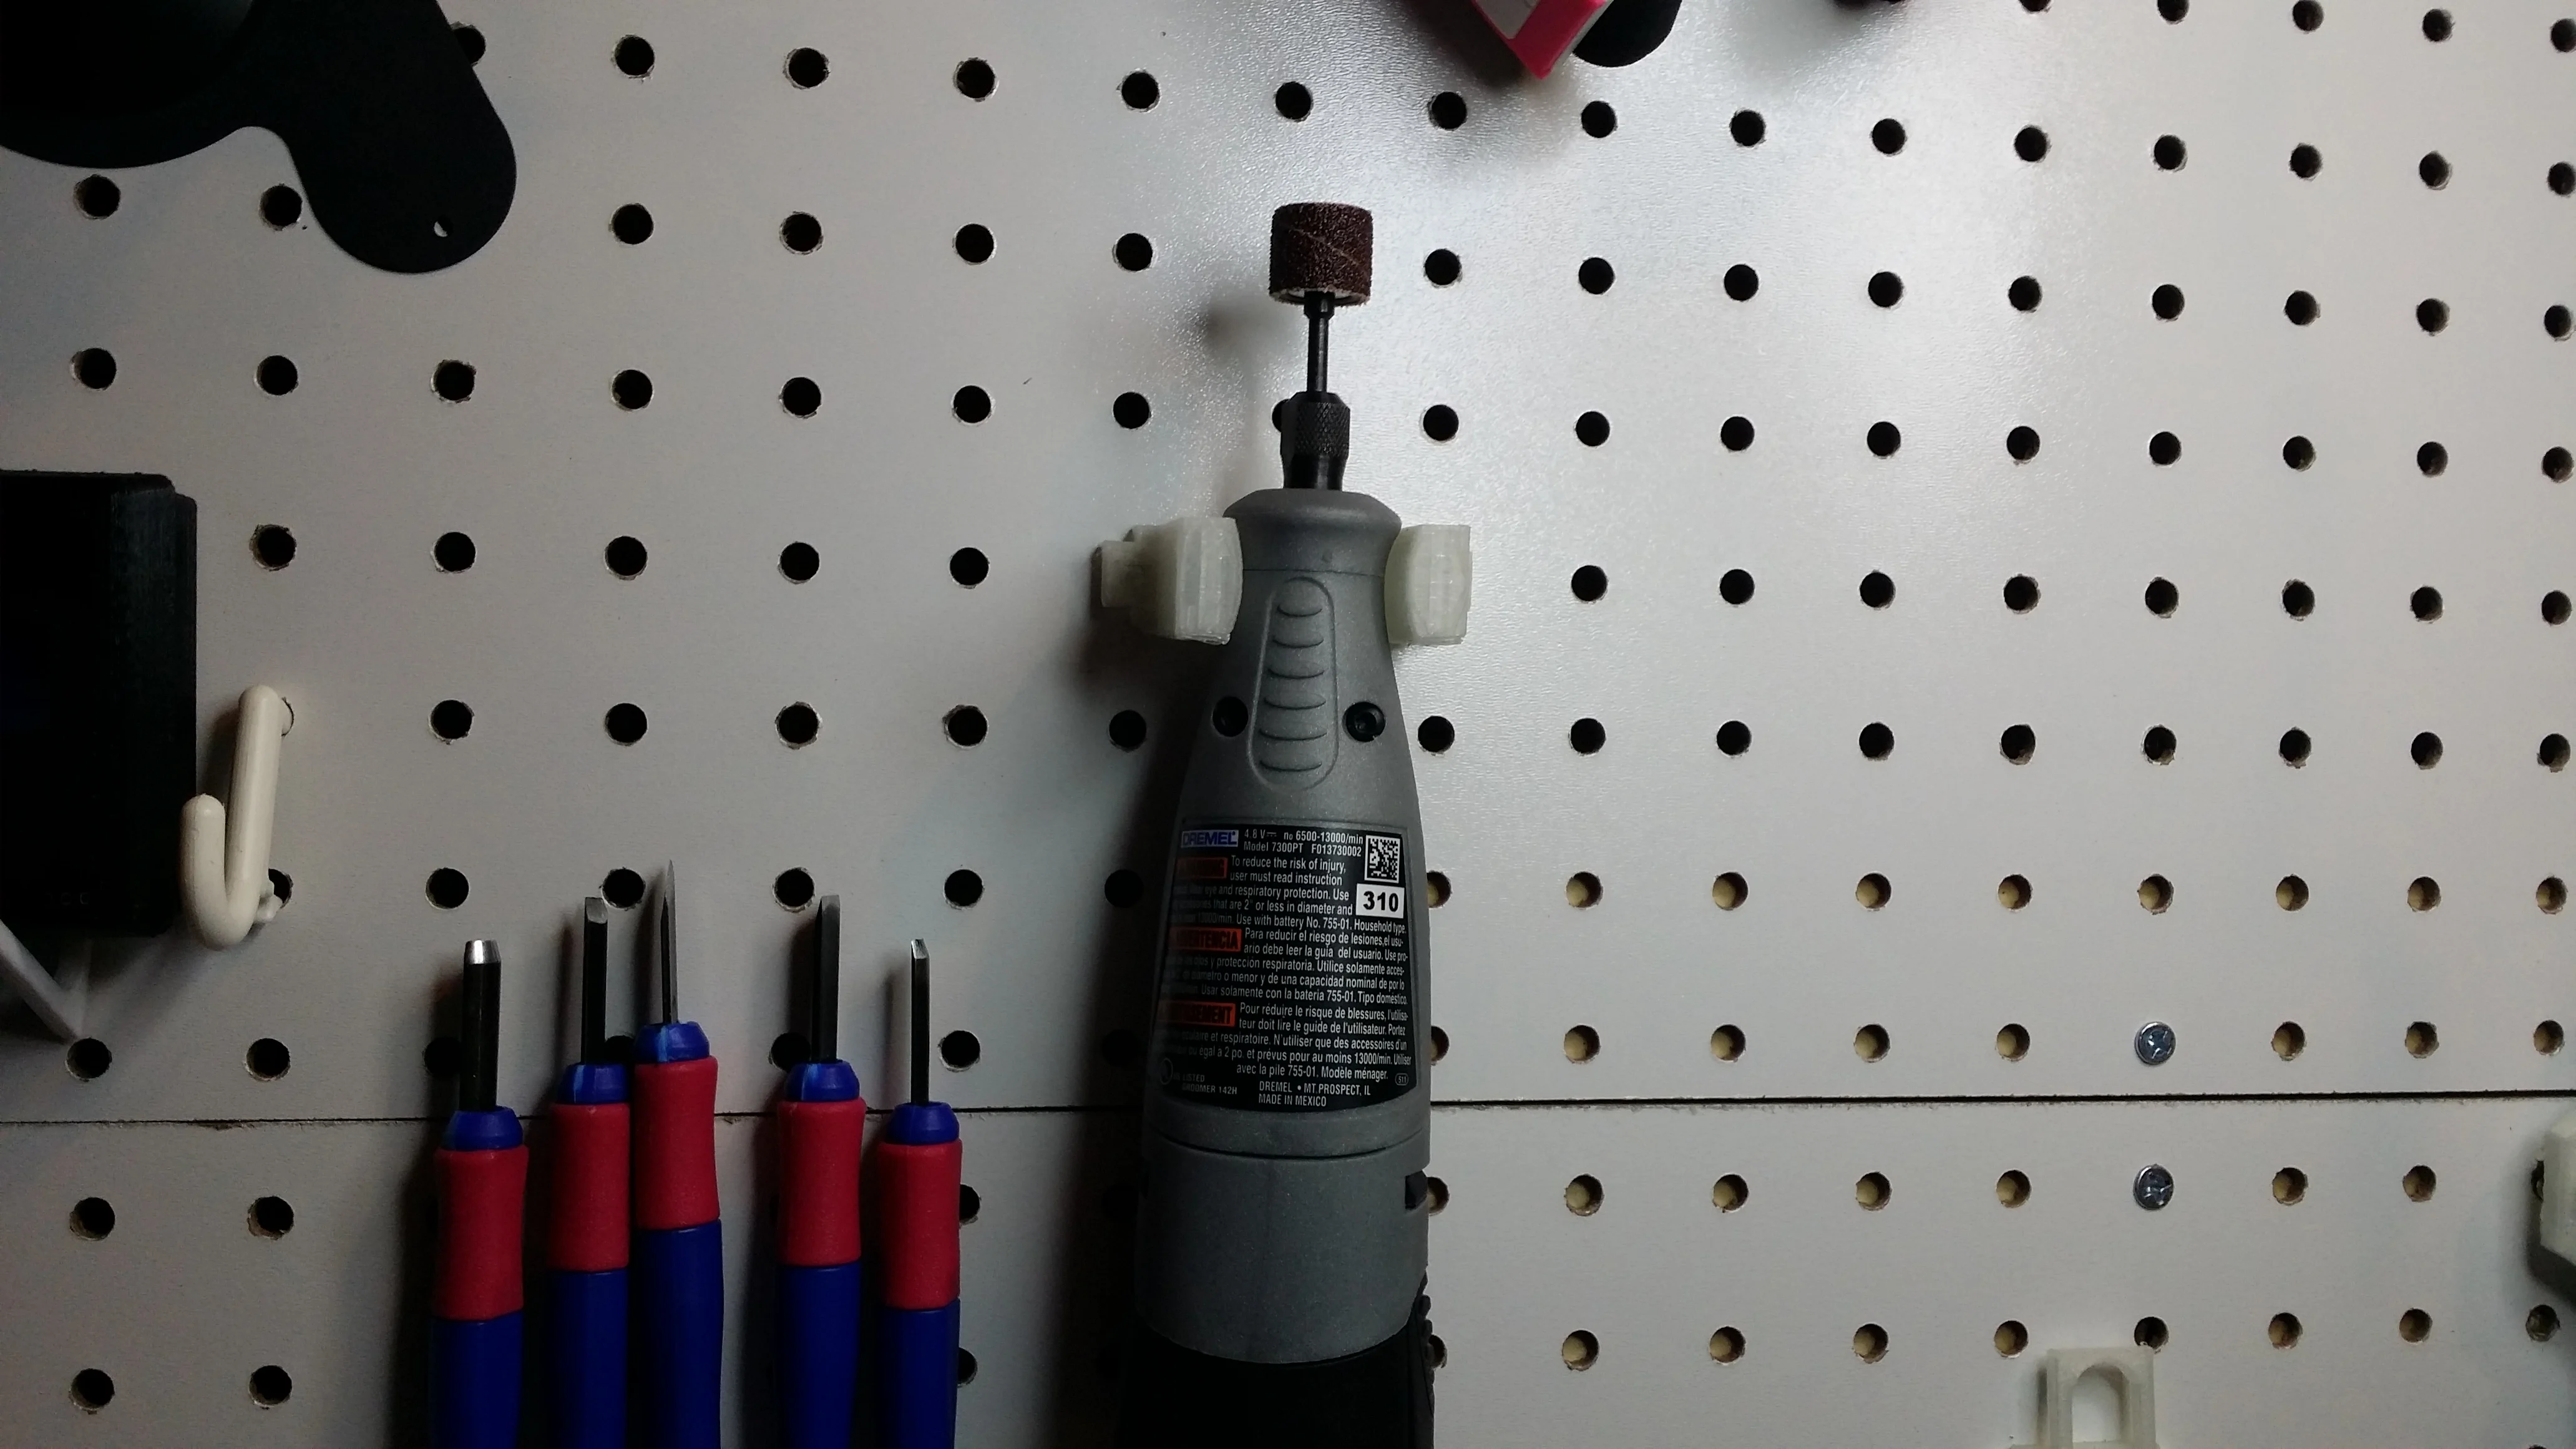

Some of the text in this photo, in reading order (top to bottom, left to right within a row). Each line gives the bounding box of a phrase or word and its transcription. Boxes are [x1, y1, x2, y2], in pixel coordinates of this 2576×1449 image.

[1183, 831, 1237, 846] DREMEL
[1244, 828, 1257, 839] 4.8
[1295, 831, 1364, 844] 6500-13000/min
[1243, 841, 1362, 857] Model 7300PT F013730002
[1231, 854, 1346, 874] To reduce the risk of injury,
[1230, 871, 1342, 886] user must read instruction
[1204, 886, 1217, 897] eye
[1218, 884, 1233, 895] and
[1235, 883, 1281, 900] respiratory
[1283, 887, 1330, 900] protection.
[1333, 889, 1350, 900] Use
[1363, 890, 1399, 912] 310
[1214, 899, 1228, 909] that
[1229, 901, 1242, 910] are
[1244, 899, 1253, 910] 2"
[1255, 902, 1265, 911] or
[1267, 900, 1284, 912] less
[1287, 900, 1295, 912] in
[1297, 901, 1335, 915] diameter
[1337, 904, 1353, 915] and
[1236, 913, 1252, 925] Use
[1254, 914, 1272, 925] with
[1274, 915, 1304, 930] battery
[1306, 915, 1320, 928] No.
[1323, 917, 1352, 930] 755-01.
[1354, 919, 1392, 932] Household
[1393, 922, 1407, 935] type.
[1244, 927, 1263, 939] Para
[1266, 929, 1297, 941] reducir
[1299, 930, 1307, 942] el
[1309, 930, 1337, 945] riesgo
[1339, 932, 1349, 944] de
[1391, 937, 1403, 947] usu-
[1244, 942, 1260, 954] ario
[1262, 943, 1284, 955] debe
[1286, 944, 1302, 956] leer
[1305, 944, 1312, 956] la
[1338, 946, 1351, 959] del
[1353, 947, 1383, 961] usuario.
[1385, 949, 1396, 962] Use
[1397, 952, 1408, 964] pro-
[1211, 956, 1215, 969] y
[1262, 959, 1315, 972] respiratoria.
[1317, 960, 1344, 972] Utilice
[1345, 962, 1385, 975] solamente
[1386, 965, 1405, 976] acces-
[1224, 972, 1229, 981] o
[1232, 973, 1258, 983] menor
[1261, 975, 1266, 986] y
[1267, 973, 1279, 984] de
[1281, 975, 1297, 985] una
[1299, 975, 1344, 988] capacidad
[1346, 976, 1377, 989] nominal
[1378, 977, 1387, 989] de
[1388, 981, 1398, 992] por
[1399, 978, 1405, 990] lo
[1201, 983, 1218, 995] Usar
[1221, 985, 1263, 998] solamente
[1266, 990, 1282, 998] con
[1284, 987, 1292, 999] la
[1327, 989, 1356, 1003] 755-01.
[1357, 991, 1374, 1006] Tipo
[1240, 1002, 1260, 1014] Pour
[1262, 1002, 1293, 1016] réduire
[1295, 1005, 1303, 1017] le
[1305, 1005, 1333, 1020] risque
[1335, 1007, 1345, 1018] de
[1347, 1007, 1387, 1022] blessures,
[1239, 1018, 1405, 1036] teur doit lire le guide de l'utilisateur. Portez
[1211, 1031, 1218, 1042] et
[1221, 1031, 1271, 1045] respiratoire.
[1274, 1033, 1313, 1047] N'utiliser
[1315, 1038, 1331, 1050] que
[1334, 1037, 1349, 1049] des
[1351, 1038, 1394, 1050] accessoires
[1395, 1039, 1407, 1051] d'un
[1199, 1044, 1216, 1060] égal
[1224, 1046, 1229, 1058] 2
[1231, 1048, 1245, 1061] po.
[1247, 1048, 1255, 1060] et
[1257, 1048, 1287, 1062] prévus
[1289, 1051, 1310, 1063] pour
[1312, 1053, 1323, 1063] au
[1325, 1051, 1352, 1064] moins
[1355, 1052, 1393, 1065] 13000/min.
[1183, 1073, 1205, 1083] LISTED
[1236, 1063, 1388, 1083] avec la pile 755-01. Modèle ménager.
[1219, 1086, 1237, 1095] 142H
[1259, 1080, 1293, 1093] DREMEL
[1365, 1085, 1371, 1096] IL
[1258, 1093, 1327, 1107] MADE IN MEXICO
